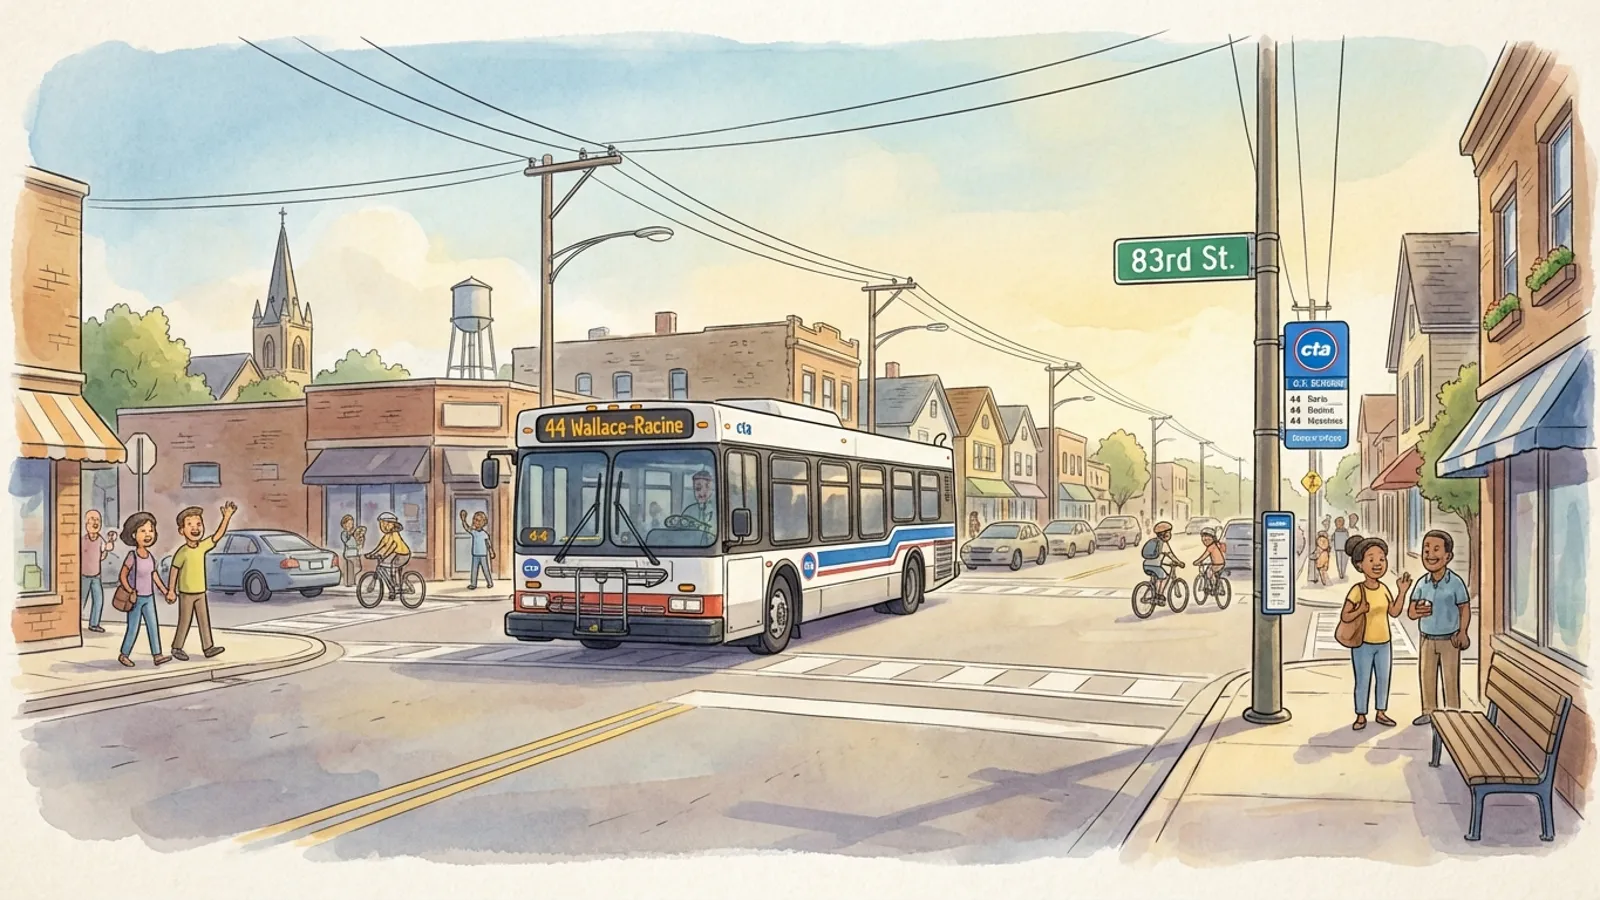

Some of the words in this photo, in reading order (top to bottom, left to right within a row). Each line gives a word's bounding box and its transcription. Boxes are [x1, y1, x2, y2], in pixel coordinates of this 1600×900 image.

[1131, 246, 1192, 273] 83rd
[1202, 244, 1235, 271] St.
[1300, 341, 1332, 357] cta
[544, 416, 566, 438] 44
[571, 414, 684, 438] Wallace-Racine
